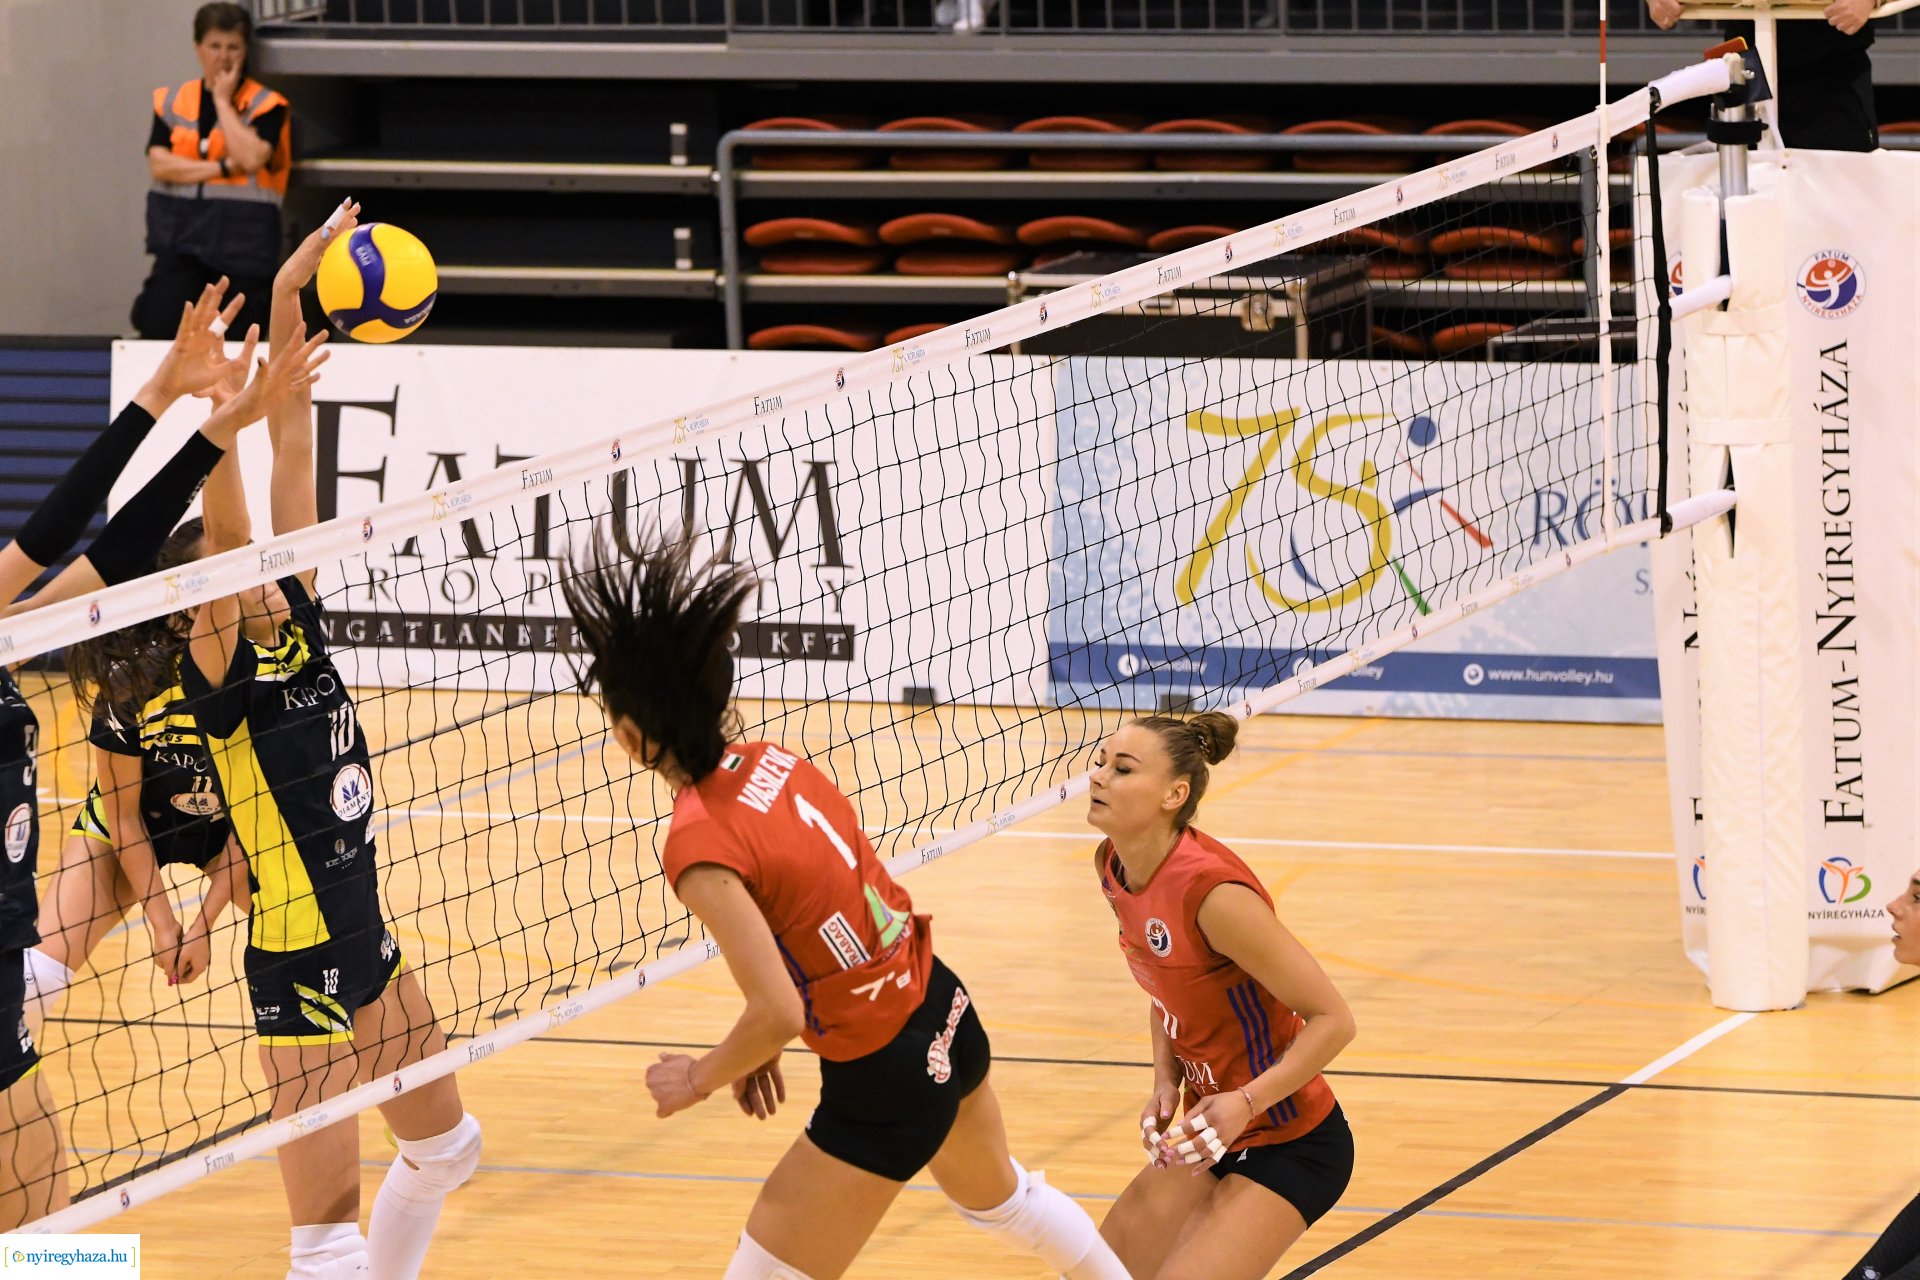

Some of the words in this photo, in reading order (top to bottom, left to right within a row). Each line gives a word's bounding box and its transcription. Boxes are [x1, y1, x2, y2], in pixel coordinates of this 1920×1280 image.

[1333, 207, 1356, 225] FATUM
[1815, 251, 1849, 262] FATUM
[1157, 265, 1182, 285] FATUM
[1802, 294, 1863, 319] NYÍREGYHÁZA
[965, 328, 991, 347] FATUM
[754, 395, 783, 416] FATUM
[521, 468, 553, 490] FATUM
[260, 549, 295, 572] FATUM
[771, 631, 846, 655] KFT
[1487, 668, 1614, 687] www.hunvolley.hu
[328, 701, 355, 761] 10
[337, 792, 370, 817] DIAMANT
[794, 793, 858, 870] 1
[921, 846, 943, 864] FATUM
[1808, 908, 1885, 920] NYÍREGYHÁZA
[828, 921, 860, 966] TRABAG
[323, 967, 339, 995] 10
[468, 1042, 495, 1063] FATUM
[205, 1152, 235, 1174] FATUM
